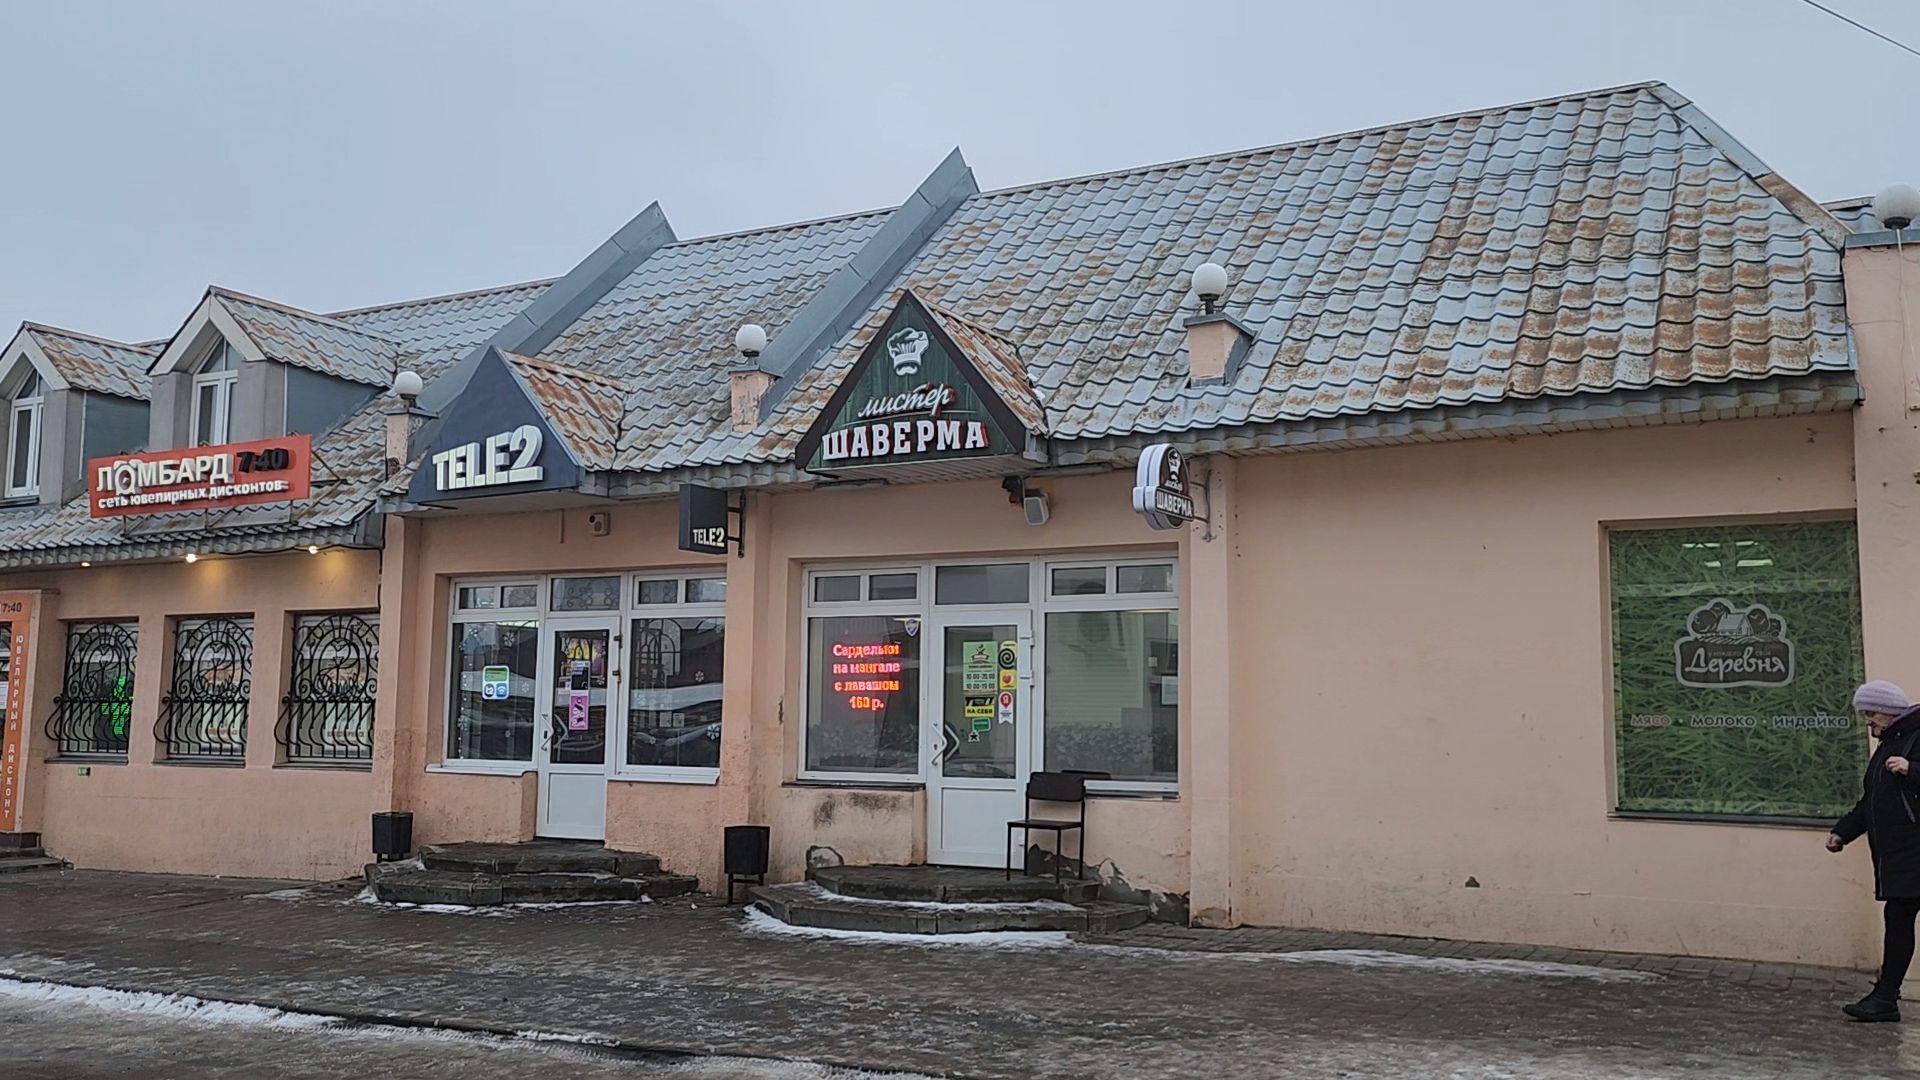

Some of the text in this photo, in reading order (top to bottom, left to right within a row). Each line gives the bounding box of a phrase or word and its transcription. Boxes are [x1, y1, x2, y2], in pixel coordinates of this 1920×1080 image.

[858, 382, 954, 417] мистер
[822, 420, 989, 461] ШАВЕРМА
[432, 424, 544, 491] TELE2
[96, 453, 234, 495] ЛОМБАРД
[98, 480, 284, 509] сеть ювелирных дисконтов
[1156, 490, 1193, 518] ШАВЕРМА
[692, 527, 725, 548] TELE2
[2, 602, 22, 613] 7:40
[832, 643, 900, 659] Сардельки
[1684, 646, 1785, 681] Деревня
[832, 662, 901, 674] на мангале
[10, 635, 24, 731] ЮВЕЛИРНЫЙ
[834, 681, 843, 692] с
[1631, 712, 1849, 730] мясо молоко индейка
[4, 743, 15, 818] ДИСКОНТ
